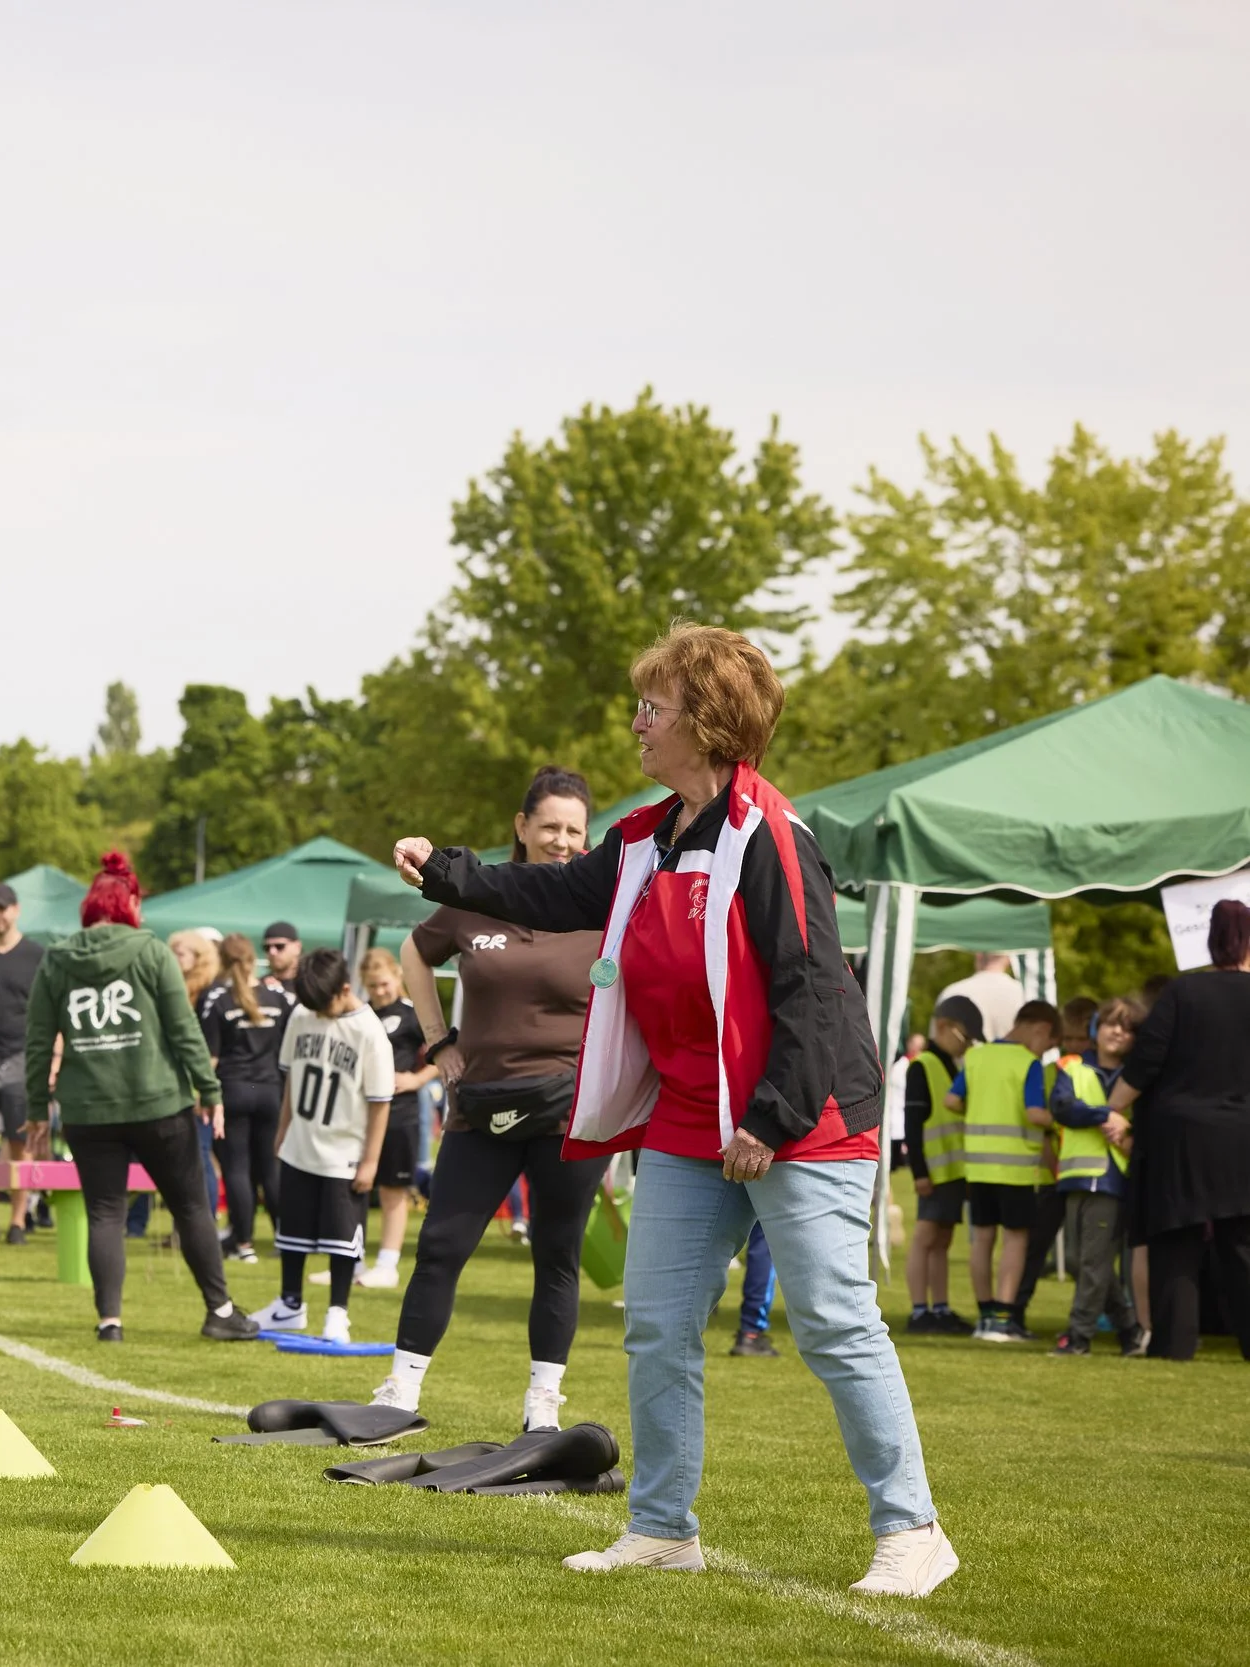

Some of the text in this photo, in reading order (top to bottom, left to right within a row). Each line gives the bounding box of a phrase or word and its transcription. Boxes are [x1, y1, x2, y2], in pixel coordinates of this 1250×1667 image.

[67, 979, 141, 1030] PUR
[293, 1033, 326, 1060] NEW
[297, 1063, 340, 1126] 01
[492, 1110, 518, 1126] NIKE
